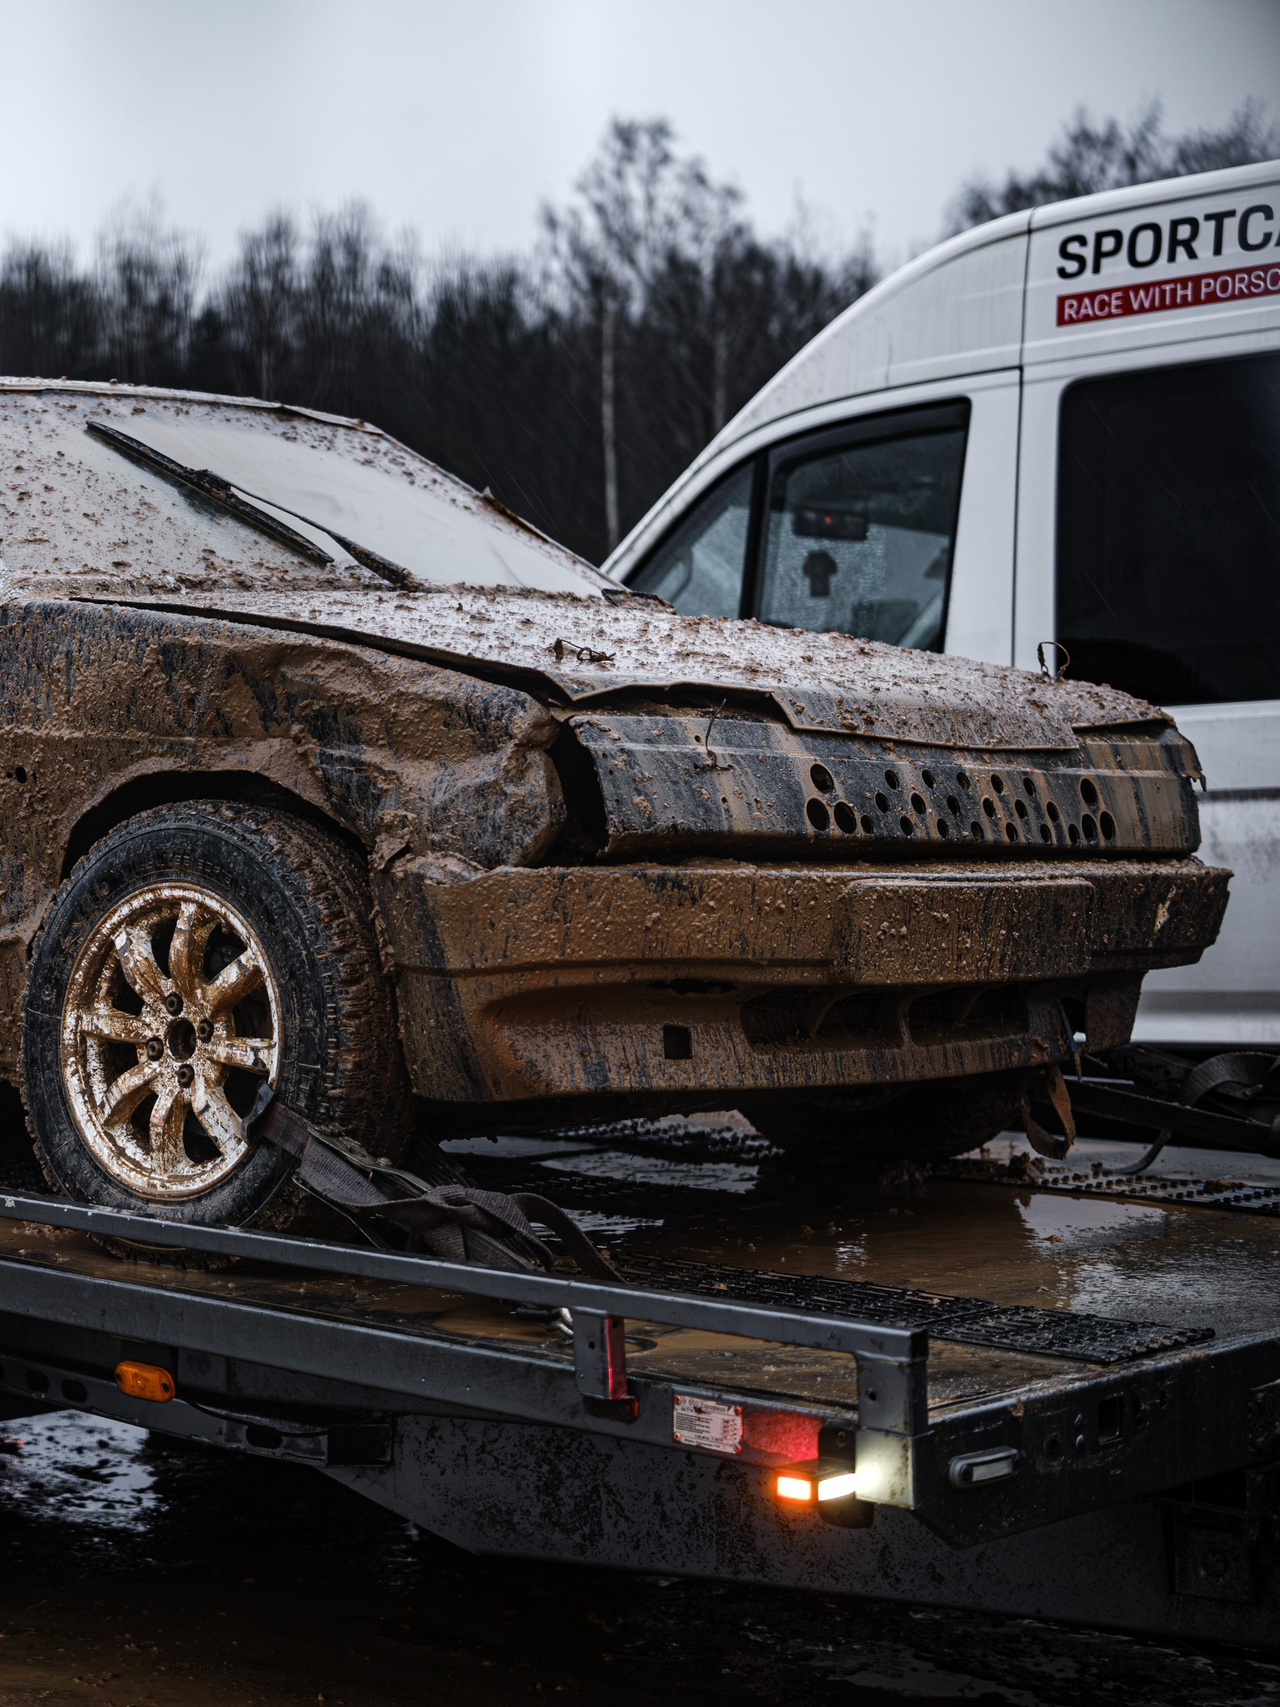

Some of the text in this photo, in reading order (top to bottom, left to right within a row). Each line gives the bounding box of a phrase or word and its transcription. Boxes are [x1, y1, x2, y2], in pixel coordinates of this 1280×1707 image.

[1057, 204, 1280, 280] SPORTC
[1064, 292, 1124, 322] RACE
[1128, 280, 1193, 312] WITH
